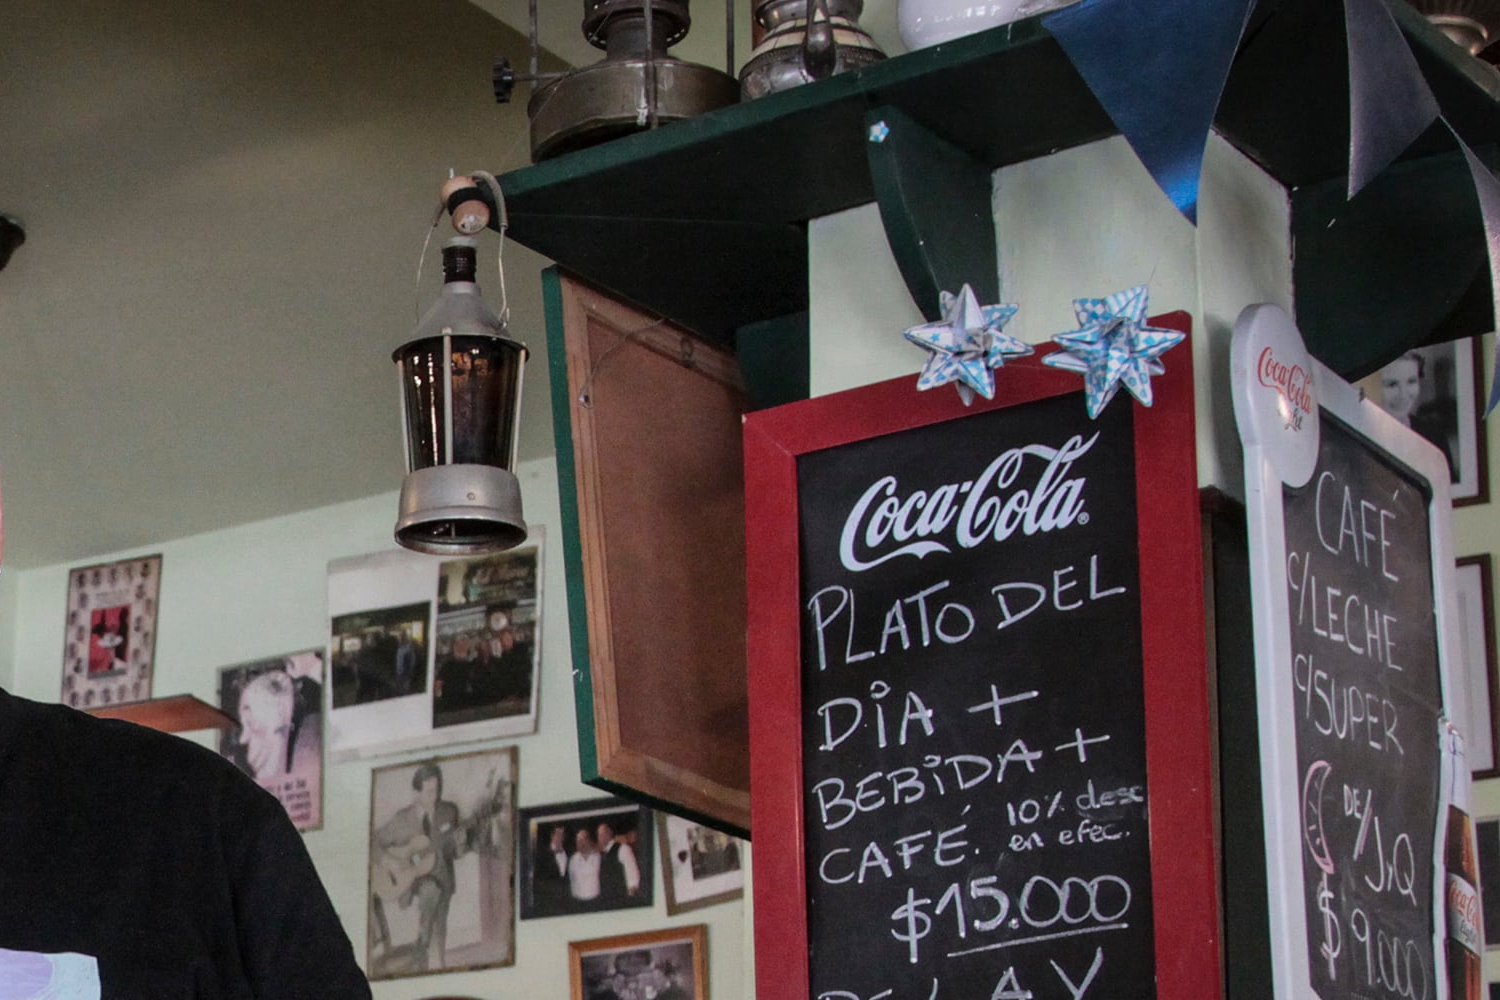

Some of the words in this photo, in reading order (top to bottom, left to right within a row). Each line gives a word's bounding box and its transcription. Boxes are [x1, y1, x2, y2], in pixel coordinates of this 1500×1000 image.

[1257, 346, 1312, 416] Coca-Cola
[839, 431, 1100, 571] Coca-Cola
[1316, 471, 1397, 583] CAFÉ
[808, 580, 974, 670] PLATO
[992, 555, 1126, 629] DEL
[1008, 831, 1045, 851] en
[890, 874, 1132, 963] $15.000
